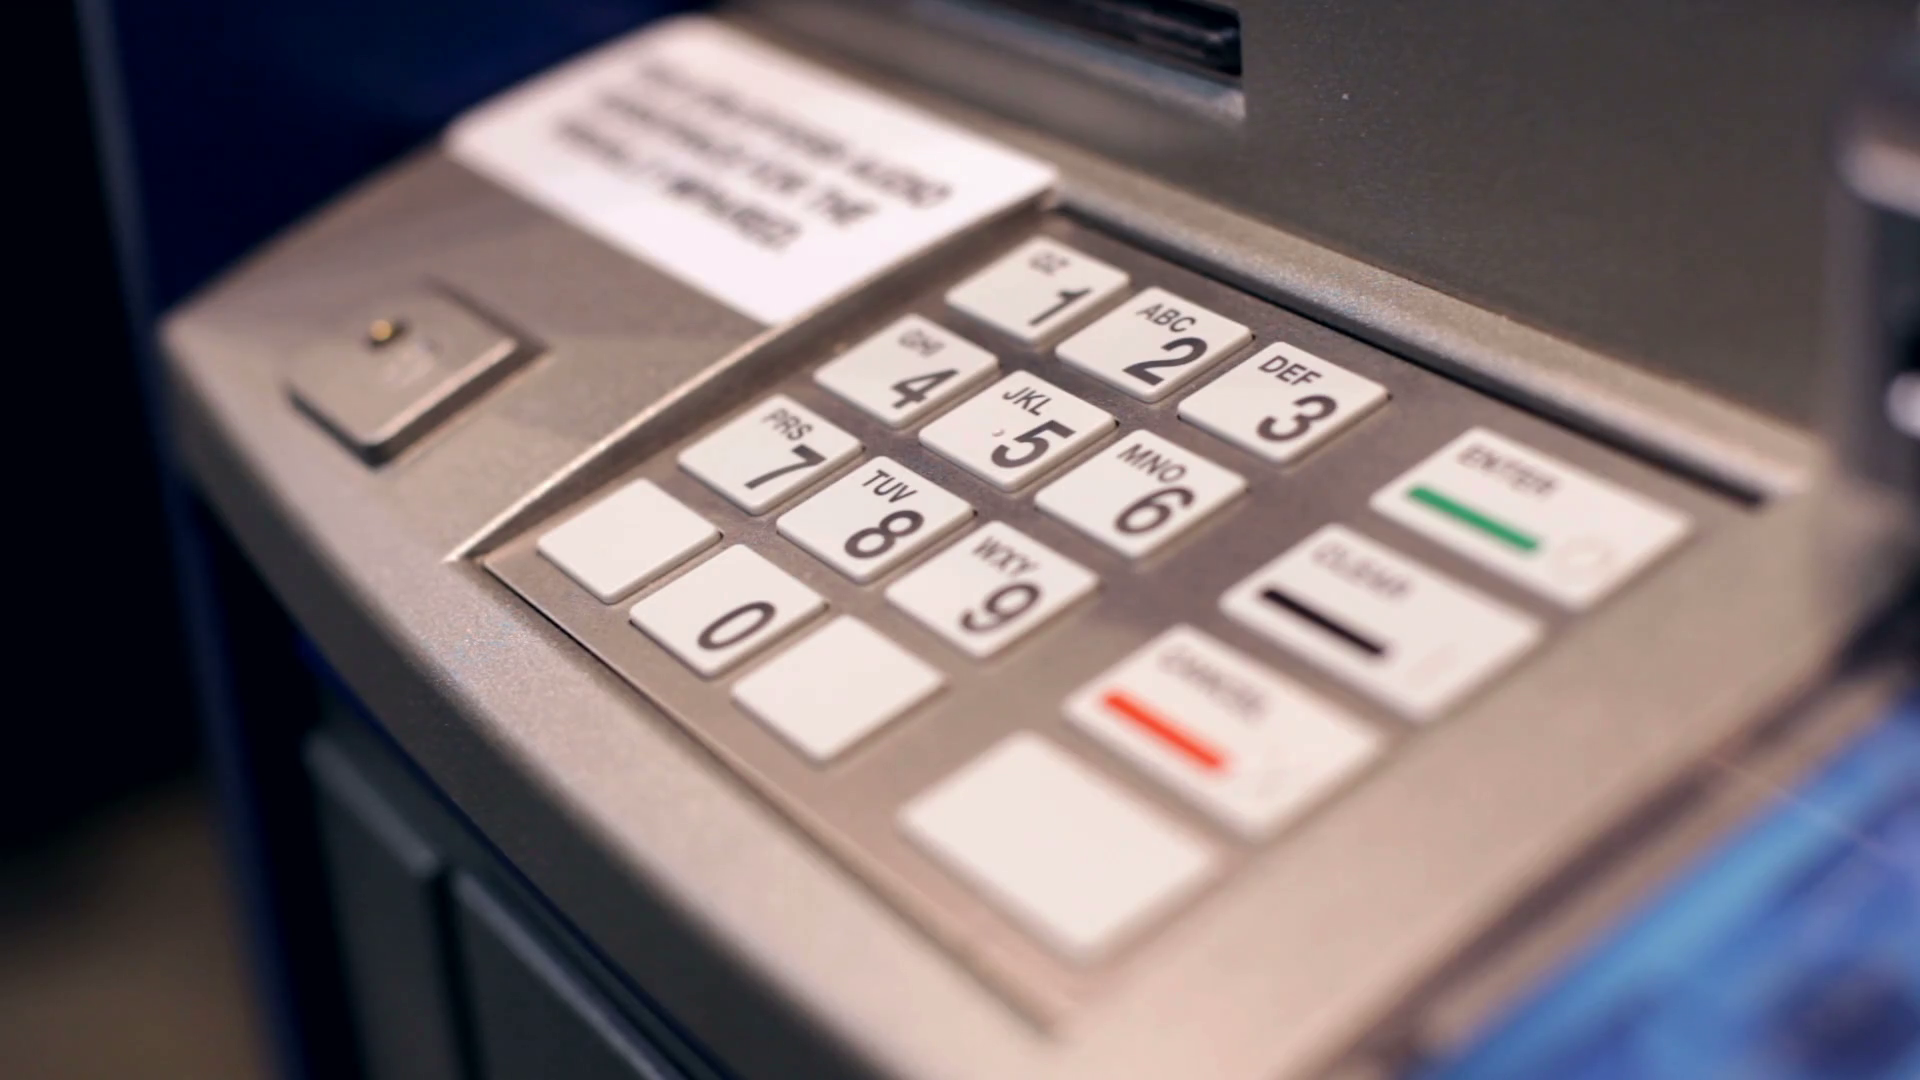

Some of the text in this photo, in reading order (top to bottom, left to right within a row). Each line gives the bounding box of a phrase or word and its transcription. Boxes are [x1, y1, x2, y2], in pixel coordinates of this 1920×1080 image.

[1030, 289, 1090, 326] 1
[1138, 304, 1196, 332] ABC
[1123, 337, 1207, 387] 2
[1258, 355, 1322, 385] DEF
[892, 369, 958, 408] 4
[1003, 387, 1051, 416] JKL
[762, 408, 815, 441] PRS
[1257, 395, 1337, 442] 3
[991, 420, 1075, 468] 5
[1118, 444, 1186, 483] MNO
[745, 444, 826, 489] 7
[863, 470, 917, 503] TUV
[1456, 444, 1559, 496] ENTER
[1115, 488, 1194, 535] 6
[845, 510, 924, 559] 8
[970, 536, 1039, 577] WXY
[698, 602, 776, 650] 0
[961, 583, 1040, 632] 9
